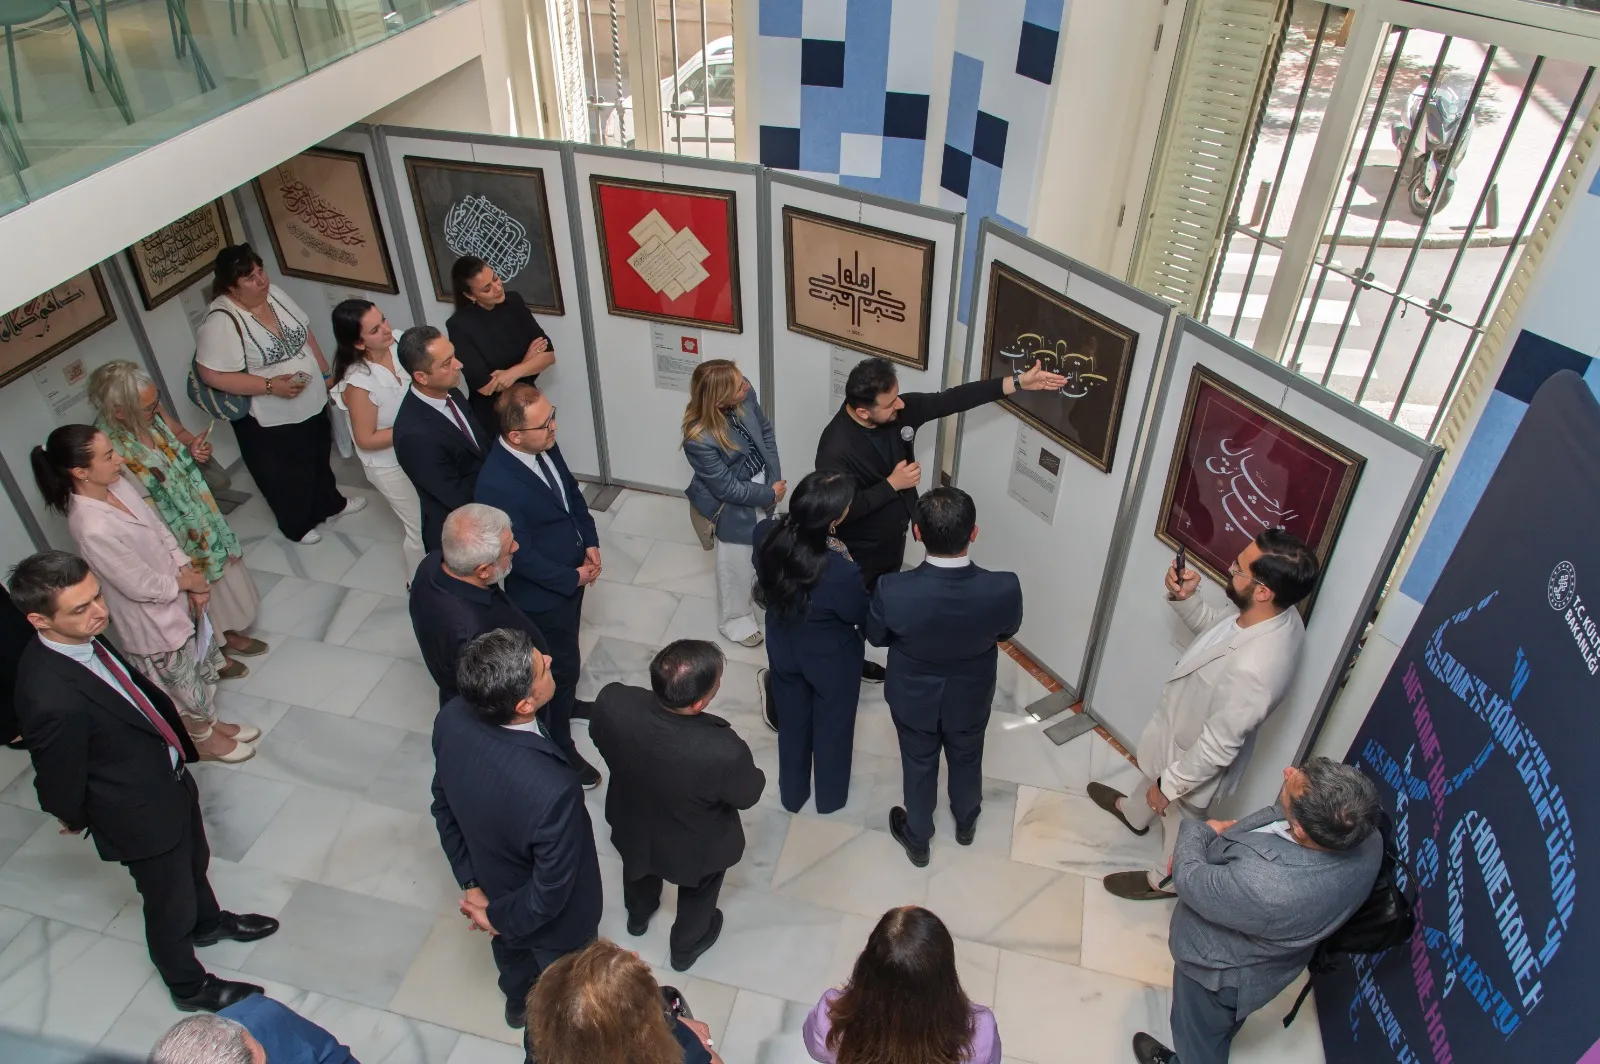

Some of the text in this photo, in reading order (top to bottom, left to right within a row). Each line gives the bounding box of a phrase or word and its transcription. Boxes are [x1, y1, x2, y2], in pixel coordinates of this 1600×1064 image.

[1564, 608, 1599, 676] BAKANLIĞI
[1572, 595, 1586, 621] T.C.
[1471, 816, 1512, 909] HOME
